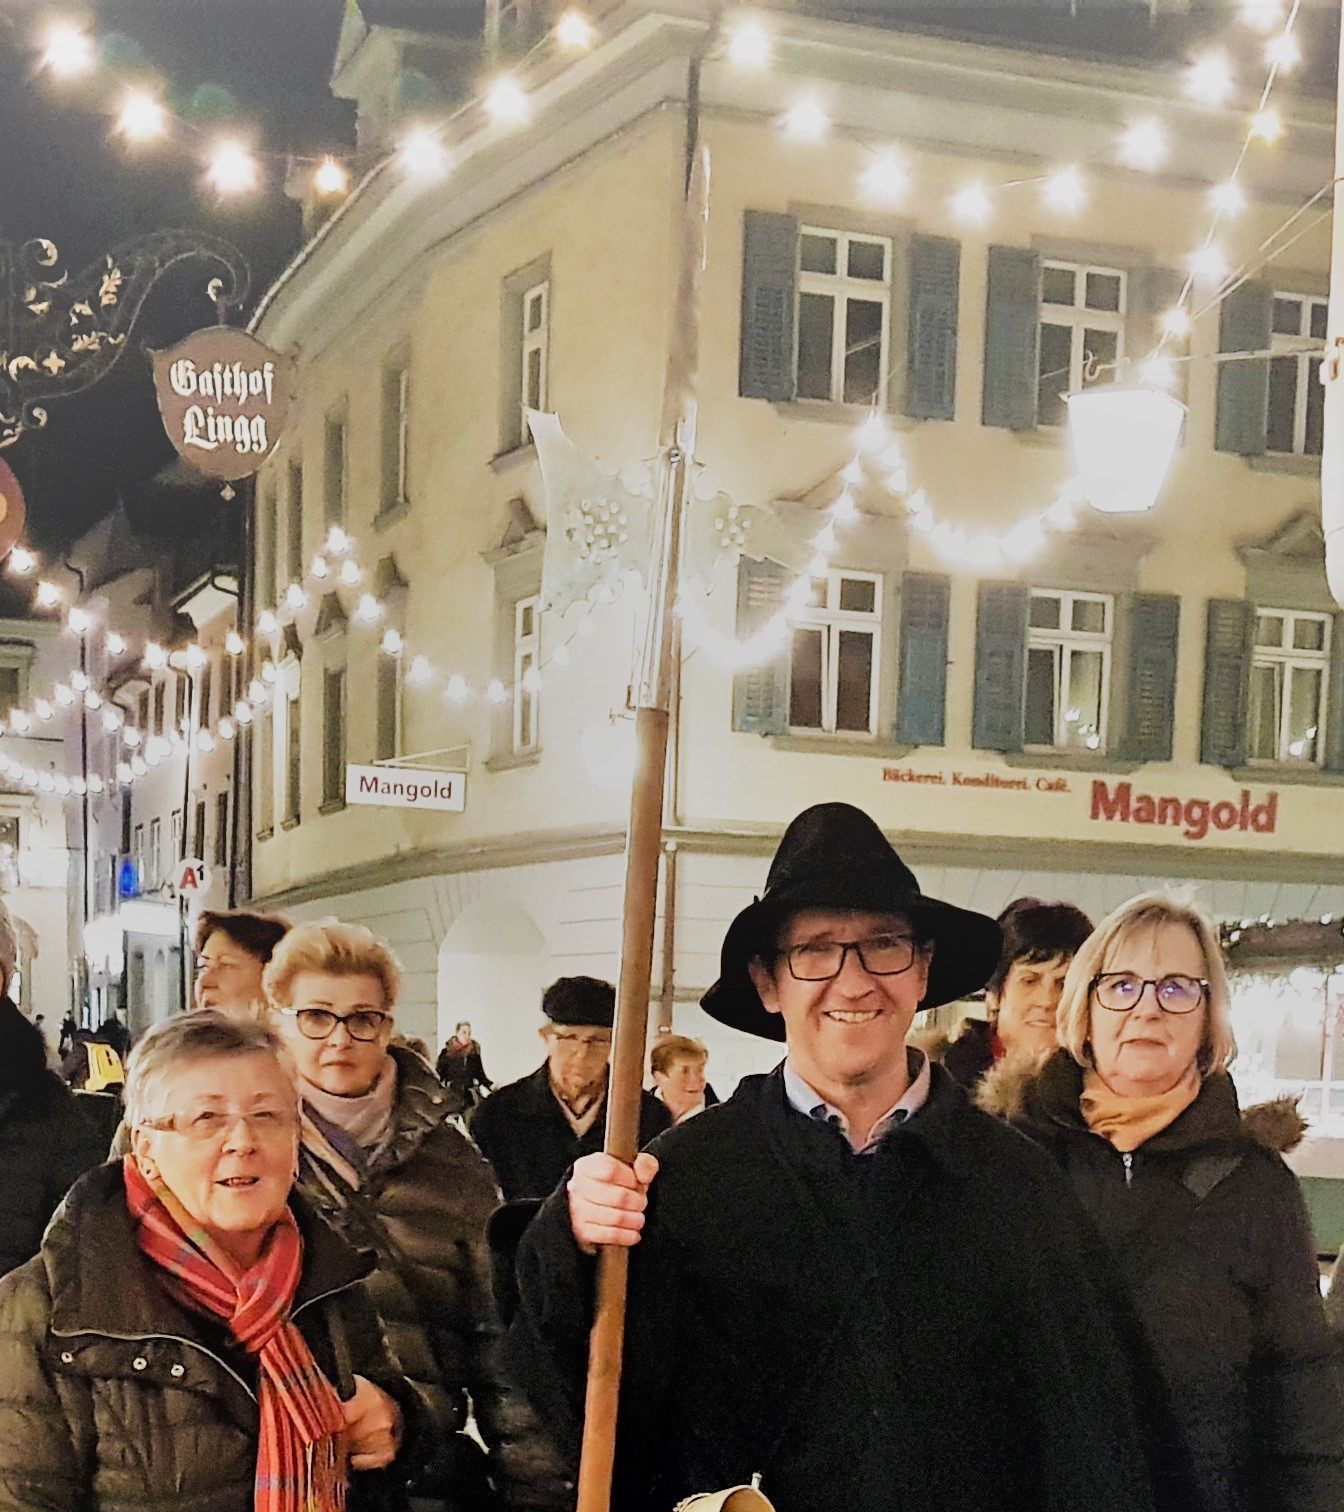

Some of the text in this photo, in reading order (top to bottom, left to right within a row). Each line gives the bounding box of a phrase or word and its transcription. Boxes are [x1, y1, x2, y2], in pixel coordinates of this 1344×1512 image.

[169, 359, 274, 406] Gasthof
[183, 405, 268, 454] Lingg
[359, 775, 452, 802] Mangold
[1090, 780, 1279, 841] Mangold
